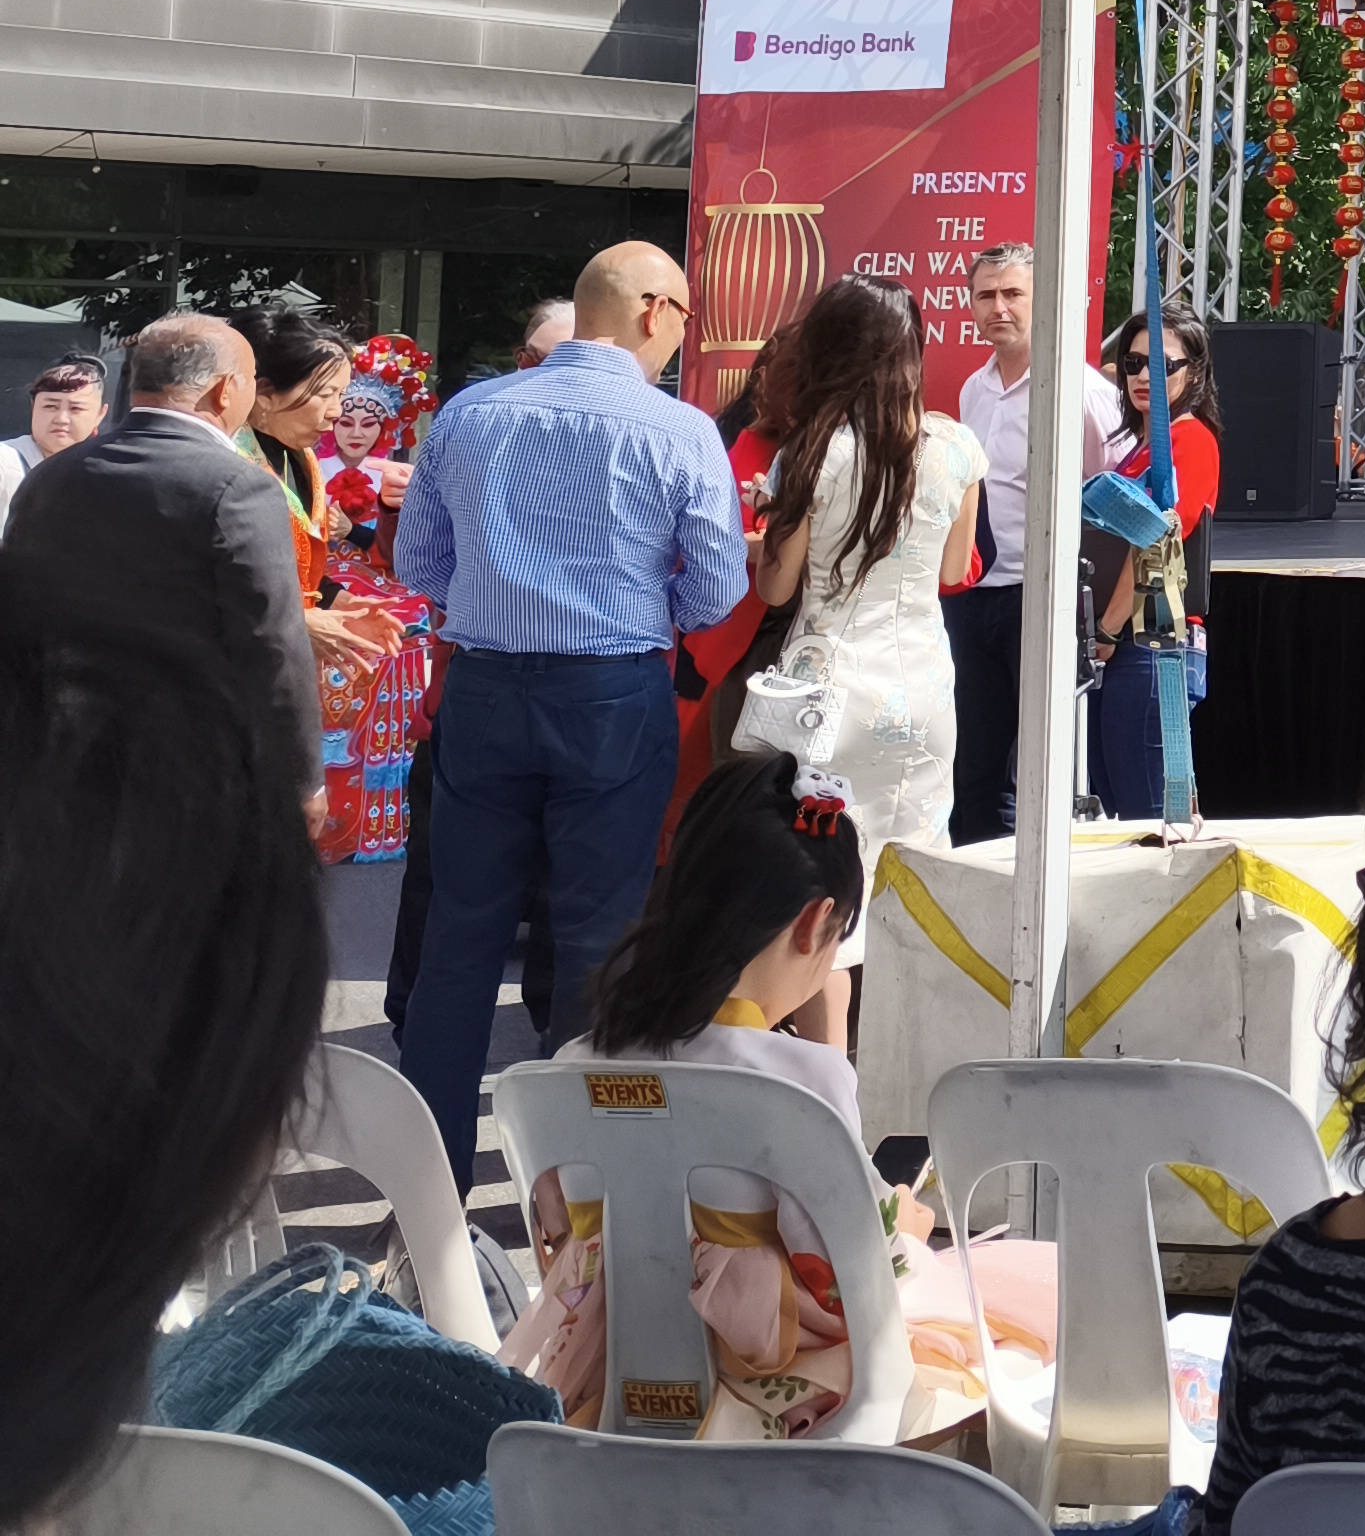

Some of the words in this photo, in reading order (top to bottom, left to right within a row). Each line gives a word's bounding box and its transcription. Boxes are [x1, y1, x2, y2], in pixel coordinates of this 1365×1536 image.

[765, 33, 856, 60] Bendigo
[862, 31, 916, 53] Bank
[911, 171, 1027, 194] PRESENTS
[936, 217, 986, 241] THE
[853, 252, 915, 276] GLEN
[591, 1083, 663, 1105] EVENTS
[626, 1392, 697, 1416] EVENTS
